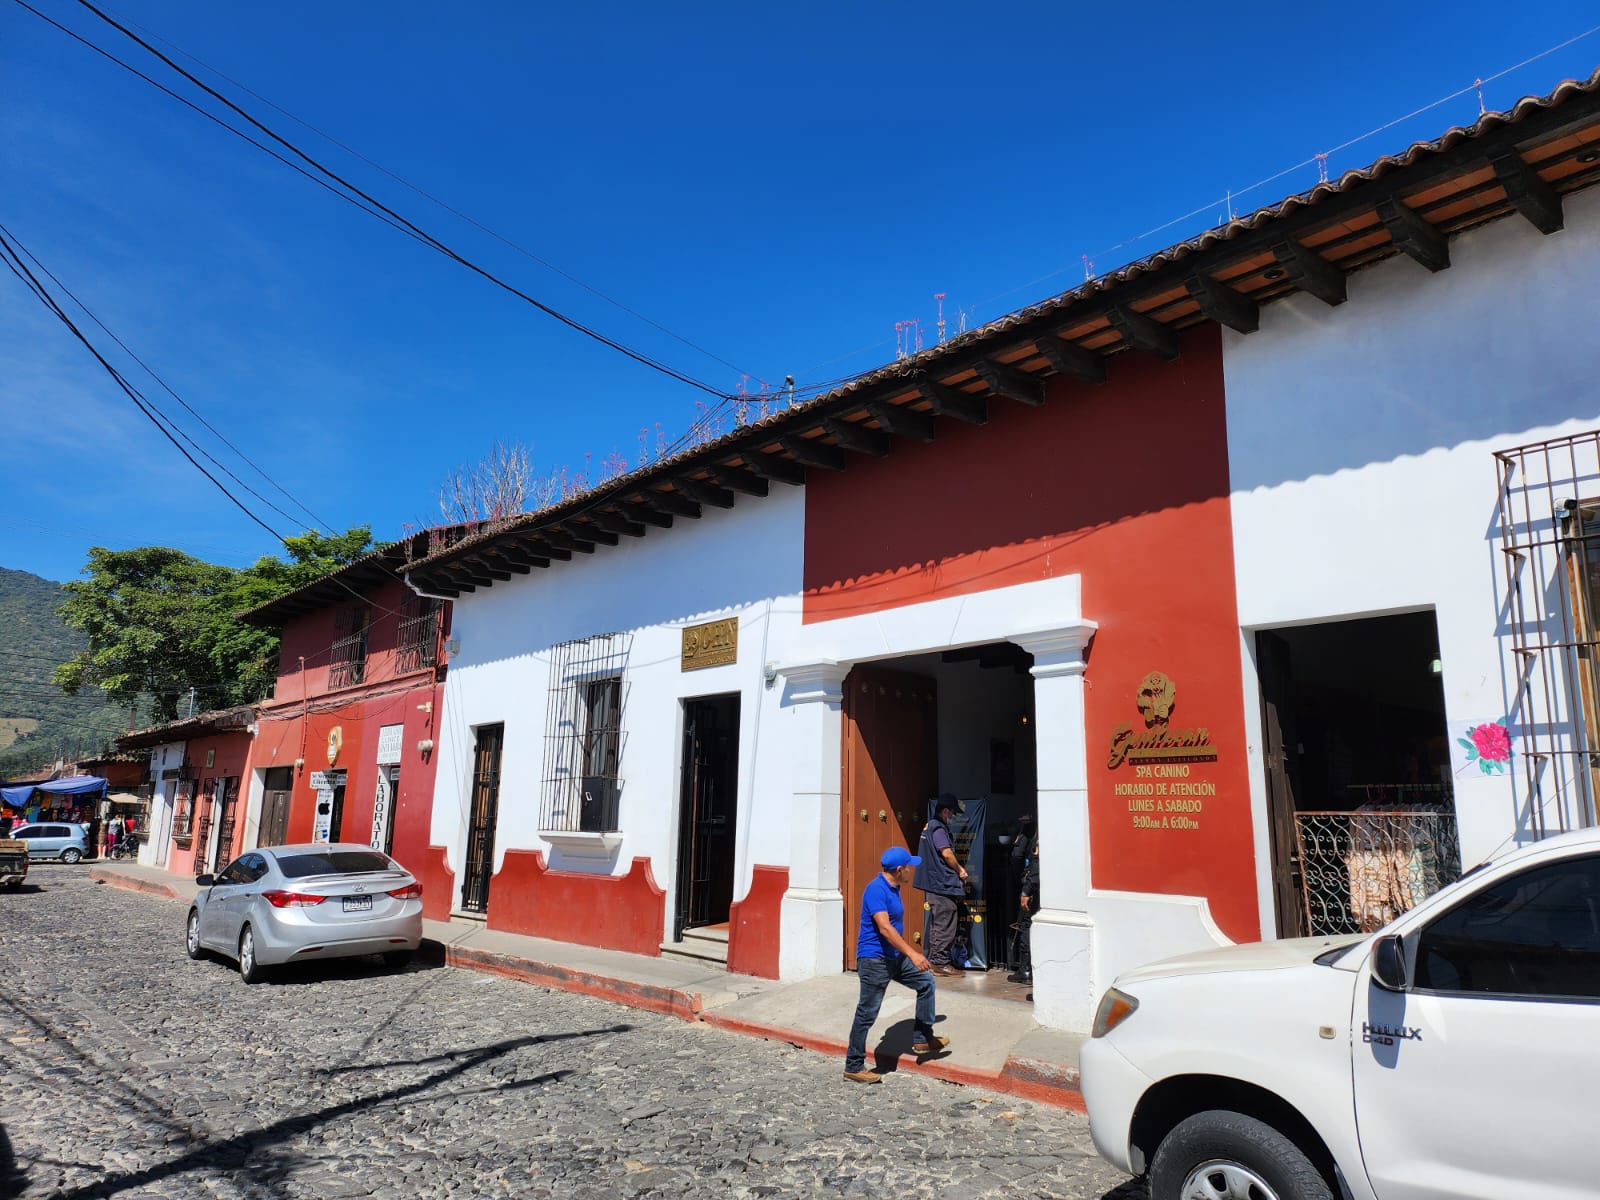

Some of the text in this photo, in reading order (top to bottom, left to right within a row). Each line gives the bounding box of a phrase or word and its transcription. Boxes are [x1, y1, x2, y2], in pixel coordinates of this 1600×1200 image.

[1136, 765, 1190, 778] SPA CANINO
[1115, 780, 1216, 796] HORARIO DE ATENCIÓN
[1128, 800, 1202, 812] LUNES A SABADO
[1162, 816, 1169, 829] A
[1362, 1022, 1423, 1041] HILUX
